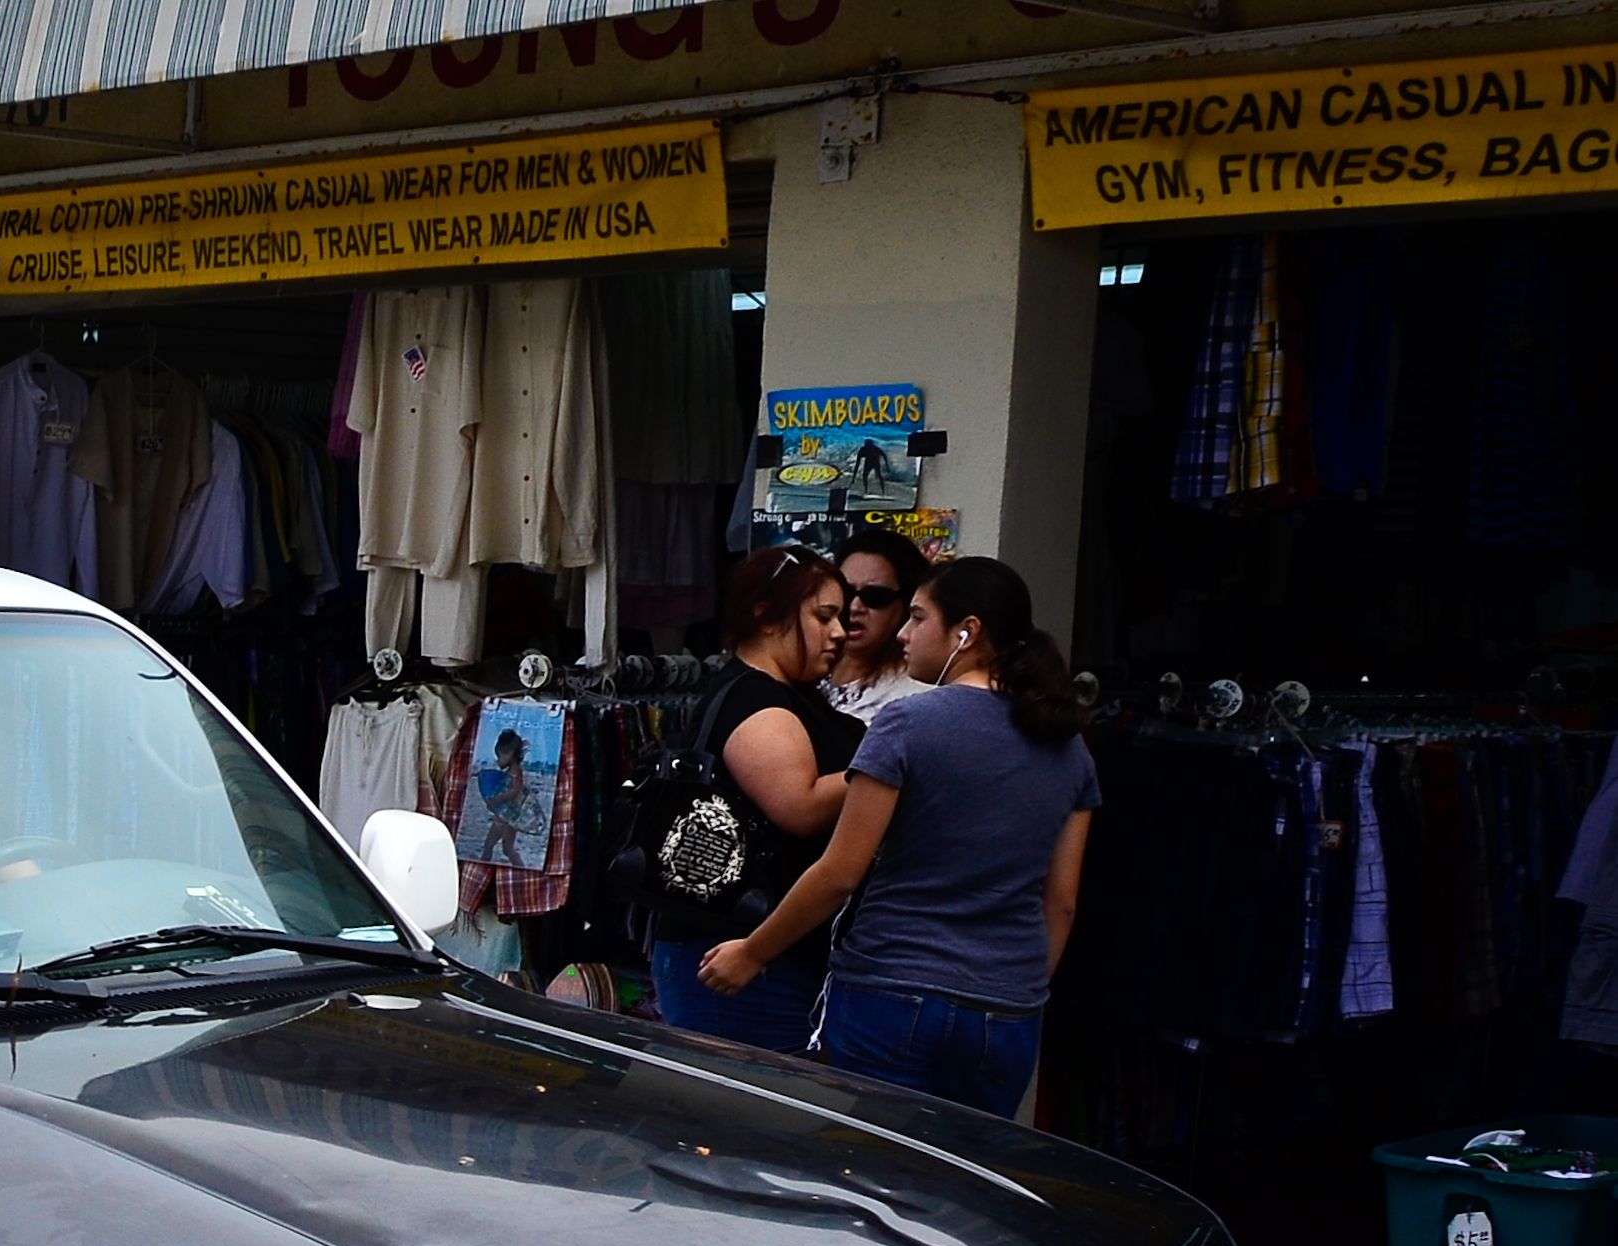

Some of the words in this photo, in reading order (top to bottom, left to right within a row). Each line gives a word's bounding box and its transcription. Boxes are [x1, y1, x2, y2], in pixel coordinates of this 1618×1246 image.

[1044, 87, 1302, 147] AMERICAN
[1319, 69, 1545, 127] CASUAL
[1562, 61, 1617, 107] IN
[49, 196, 134, 233] COTTON
[139, 180, 279, 227] PRE-SHRUNK
[284, 171, 376, 211] CASUAL
[382, 163, 453, 202] WEAR
[459, 156, 509, 195] FOR
[515, 152, 570, 191] MEN
[580, 152, 597, 185] &
[602, 139, 708, 183] WOMEN
[1095, 159, 1205, 205] GYM,
[1219, 140, 1457, 196] FITNESS,
[1480, 127, 1618, 179] BAG
[7, 248, 88, 284] CRUISE,
[93, 239, 186, 279] LEISURE,
[192, 229, 309, 271] WEEKEND,
[313, 221, 404, 262] TRAVEL
[409, 215, 483, 253] WEAR
[489, 208, 563, 248] MADE
[563, 207, 589, 241] IN
[595, 200, 656, 240] USA
[773, 393, 922, 430] SKIMBOARDS
[799, 434, 821, 458] by
